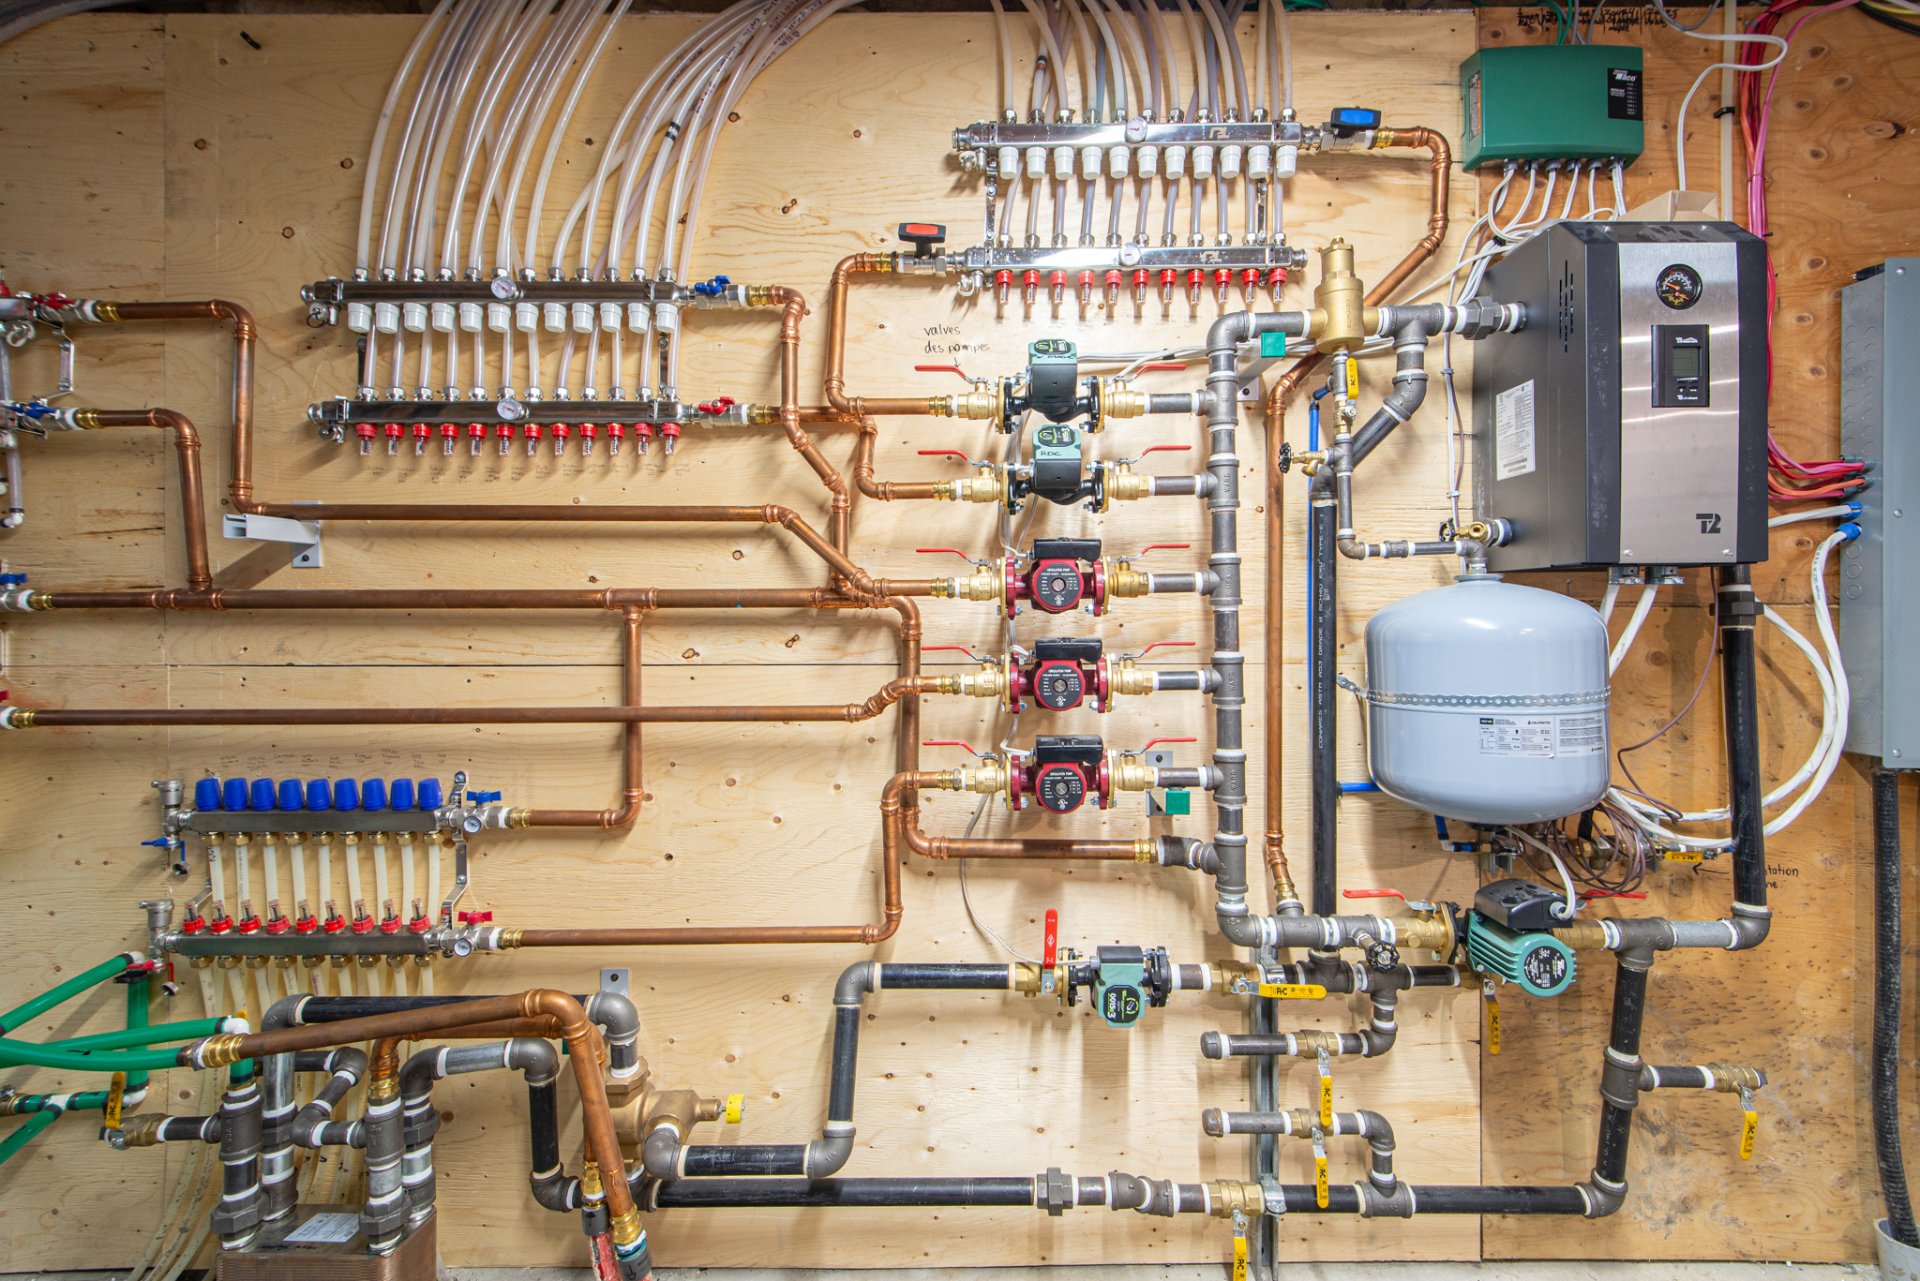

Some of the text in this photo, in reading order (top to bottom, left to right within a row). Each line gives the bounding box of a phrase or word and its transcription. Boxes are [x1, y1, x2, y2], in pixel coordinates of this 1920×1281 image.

[924, 340, 944, 354] des
[1696, 513, 1721, 534] T2
[1766, 864, 1799, 878] tation
